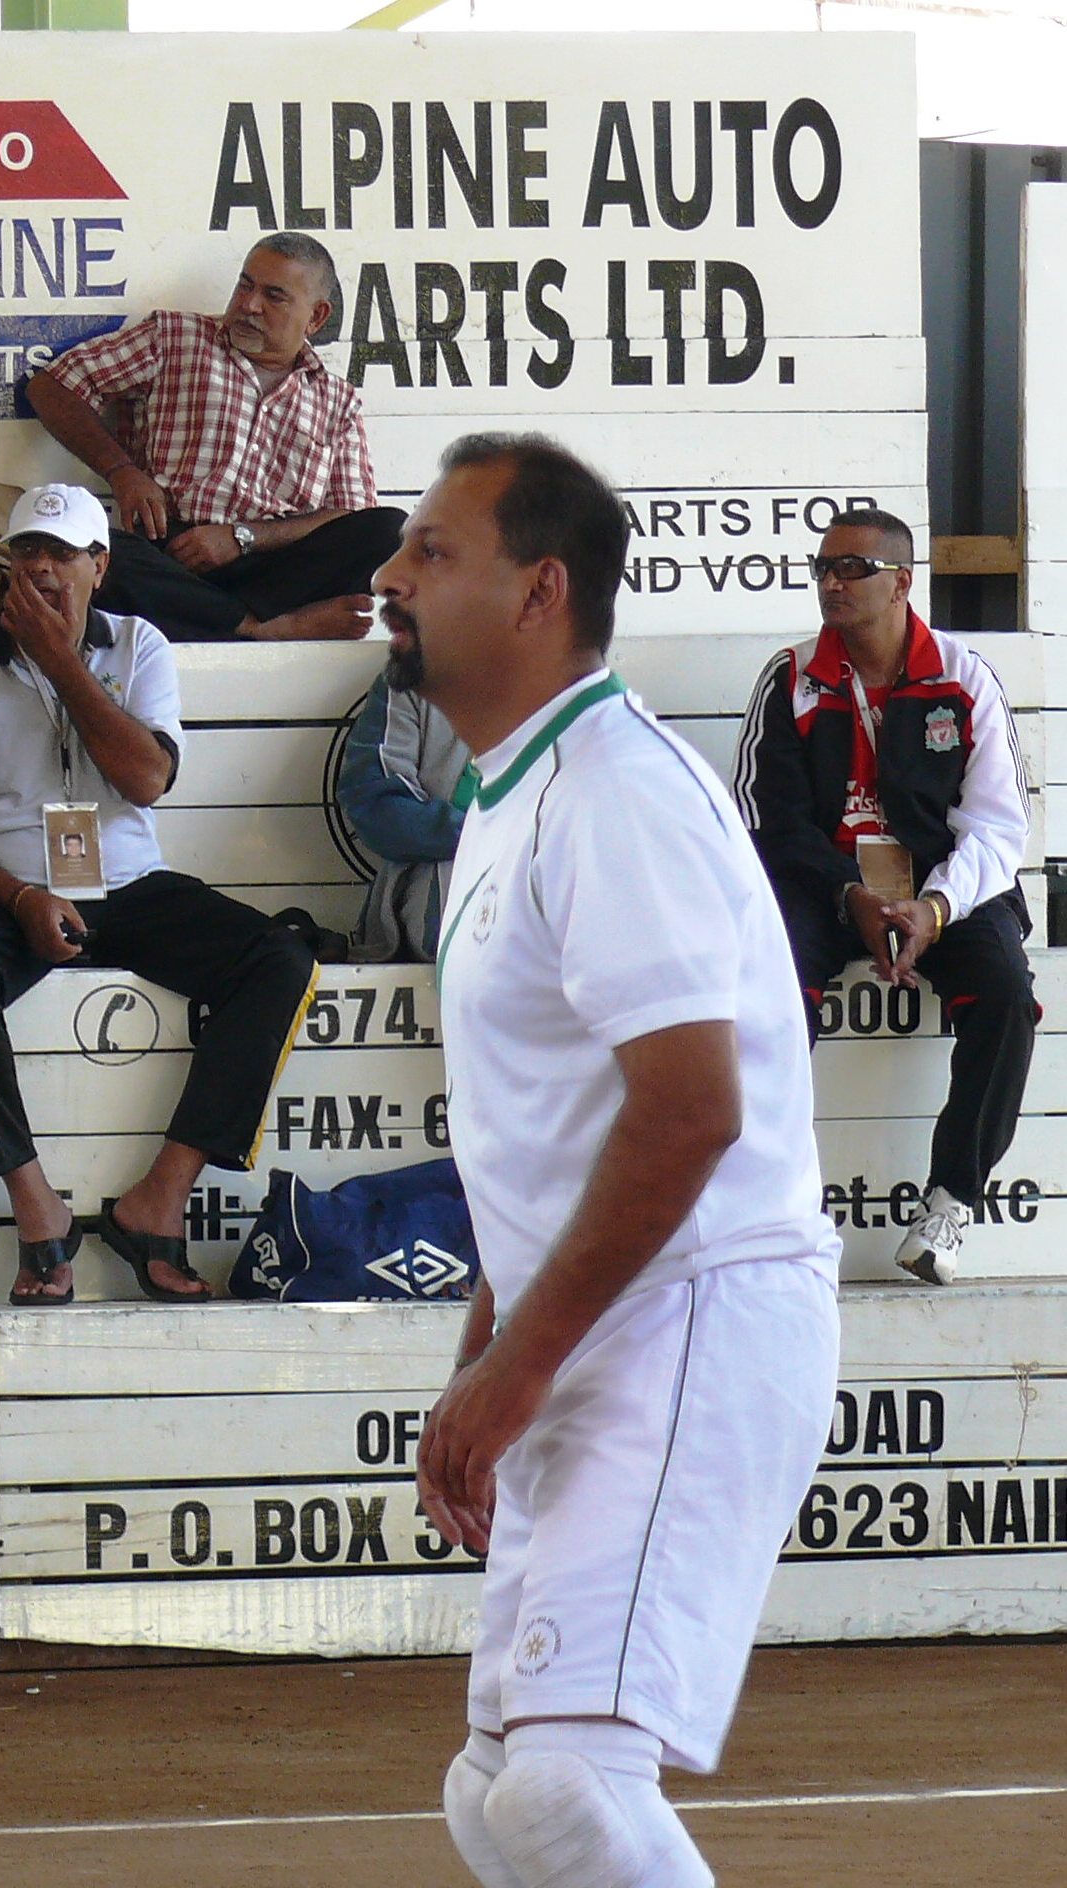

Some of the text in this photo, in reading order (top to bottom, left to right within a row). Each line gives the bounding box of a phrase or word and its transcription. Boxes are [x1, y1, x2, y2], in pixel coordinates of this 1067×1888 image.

[208, 98, 842, 230] ALPINE AUTO
[607, 259, 796, 386] LTD.
[698, 553, 820, 593] VOL
[276, 1094, 403, 1151] FAX:
[356, 1409, 433, 1466] OF
[254, 1495, 390, 1565] BOX
[782, 1481, 929, 1551] 623
